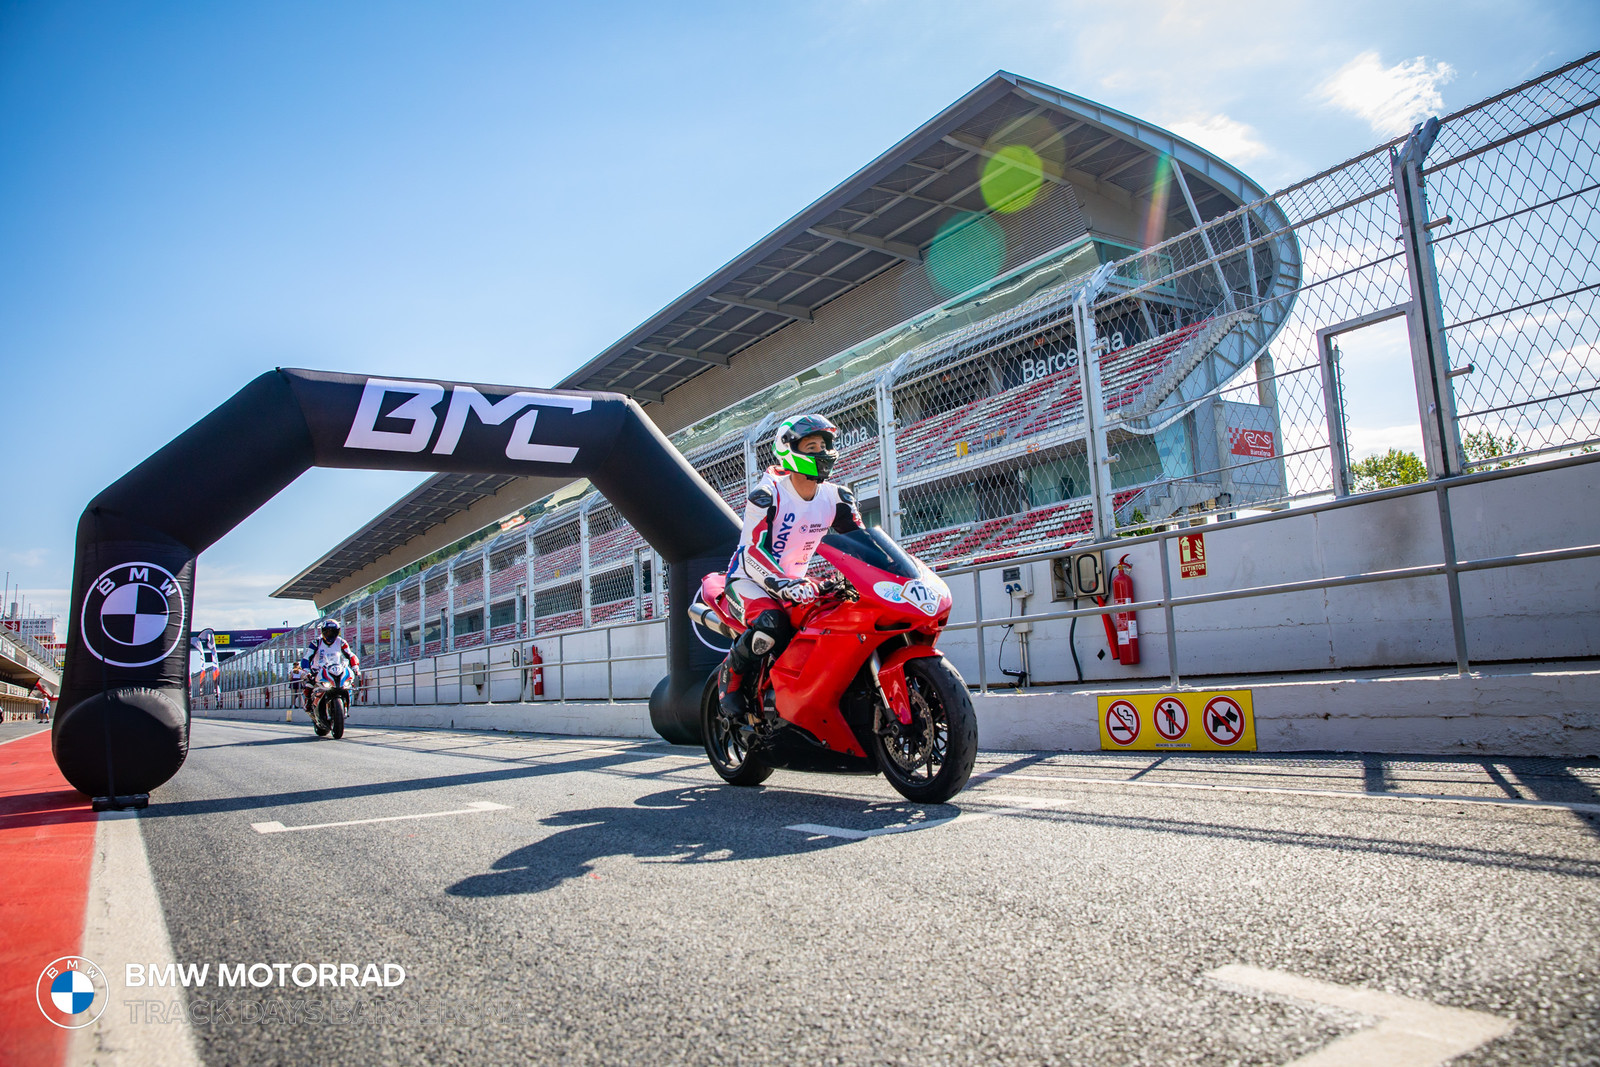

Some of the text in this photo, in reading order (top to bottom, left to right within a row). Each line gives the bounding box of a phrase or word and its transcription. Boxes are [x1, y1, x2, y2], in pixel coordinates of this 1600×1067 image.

[1022, 331, 1125, 382] Barcena
[343, 378, 593, 464] BMC
[96, 567, 178, 597] BMW
[1182, 563, 1205, 573] EXTINTOR
